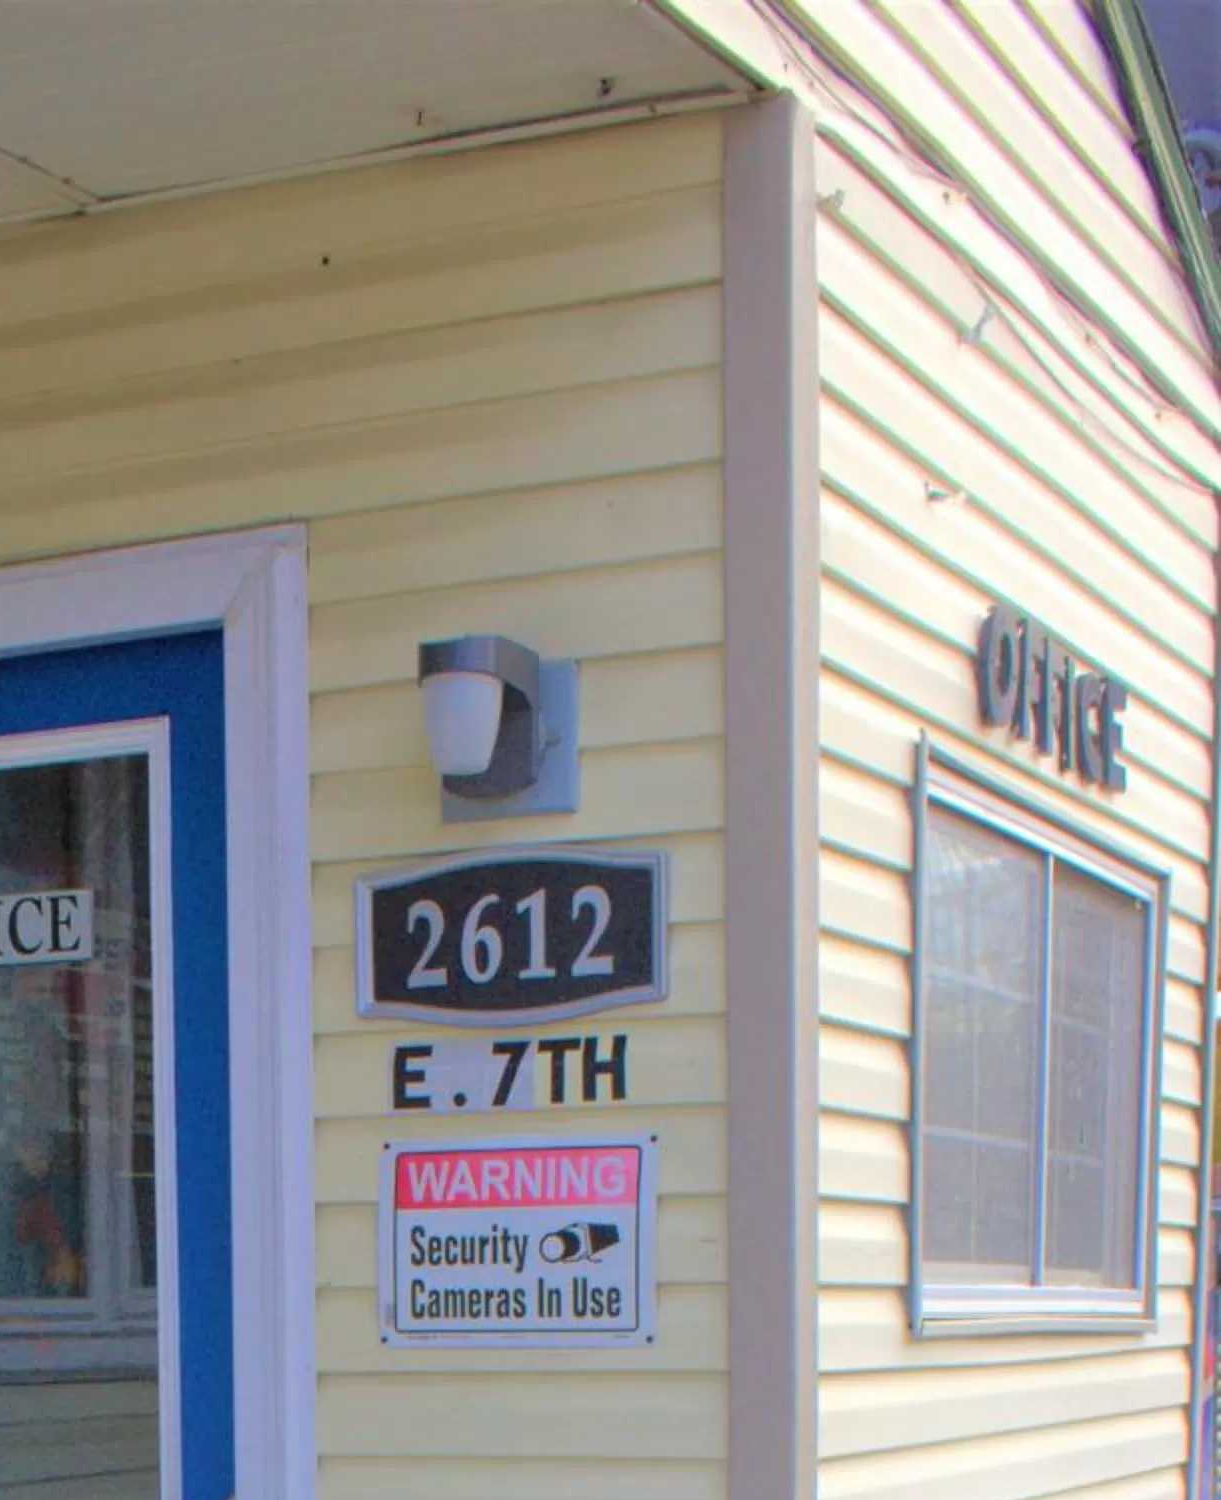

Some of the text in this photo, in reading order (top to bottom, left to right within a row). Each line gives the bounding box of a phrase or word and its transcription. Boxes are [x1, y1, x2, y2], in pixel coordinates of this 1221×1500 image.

[978, 603, 1128, 793] OFFICE
[406, 885, 614, 988] 2612
[408, 1155, 627, 1202] WARNING
[410, 1225, 528, 1273] Security
[410, 1279, 526, 1319] Cameras
[539, 1277, 562, 1317] In
[573, 1275, 621, 1317] Use
